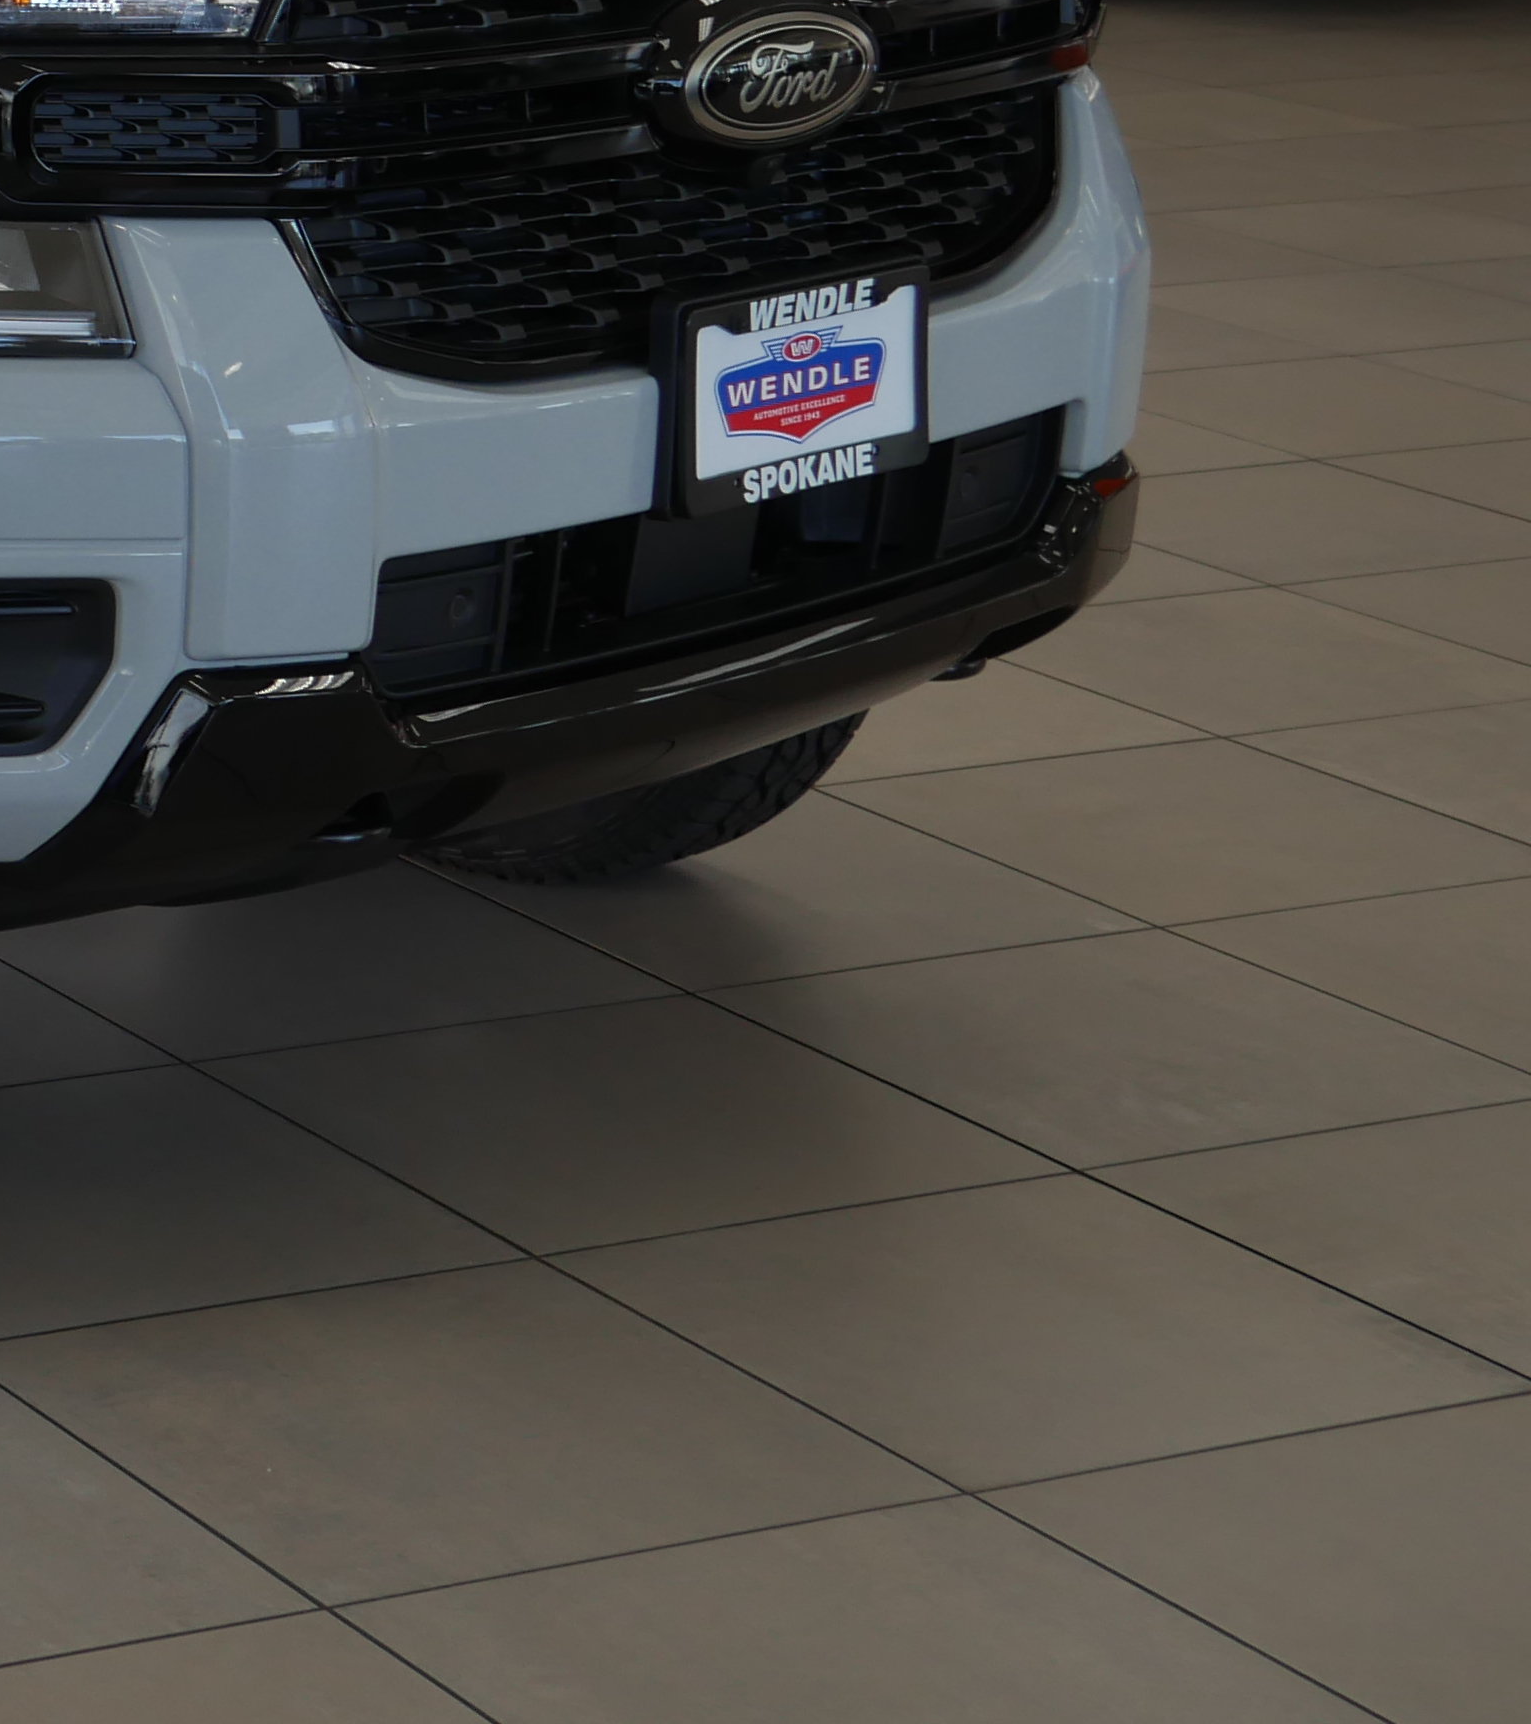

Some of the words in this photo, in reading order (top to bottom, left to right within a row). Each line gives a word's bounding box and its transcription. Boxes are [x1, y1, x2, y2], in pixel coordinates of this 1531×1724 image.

[740, 40, 840, 114] Ford
[749, 277, 875, 332] WENDLE
[727, 356, 871, 408] WENDLE
[753, 403, 799, 421] AUTOMOTIVE
[800, 394, 846, 412] EXCELLENCE
[780, 414, 803, 427] SINCE
[743, 442, 874, 504] SPOKANE
